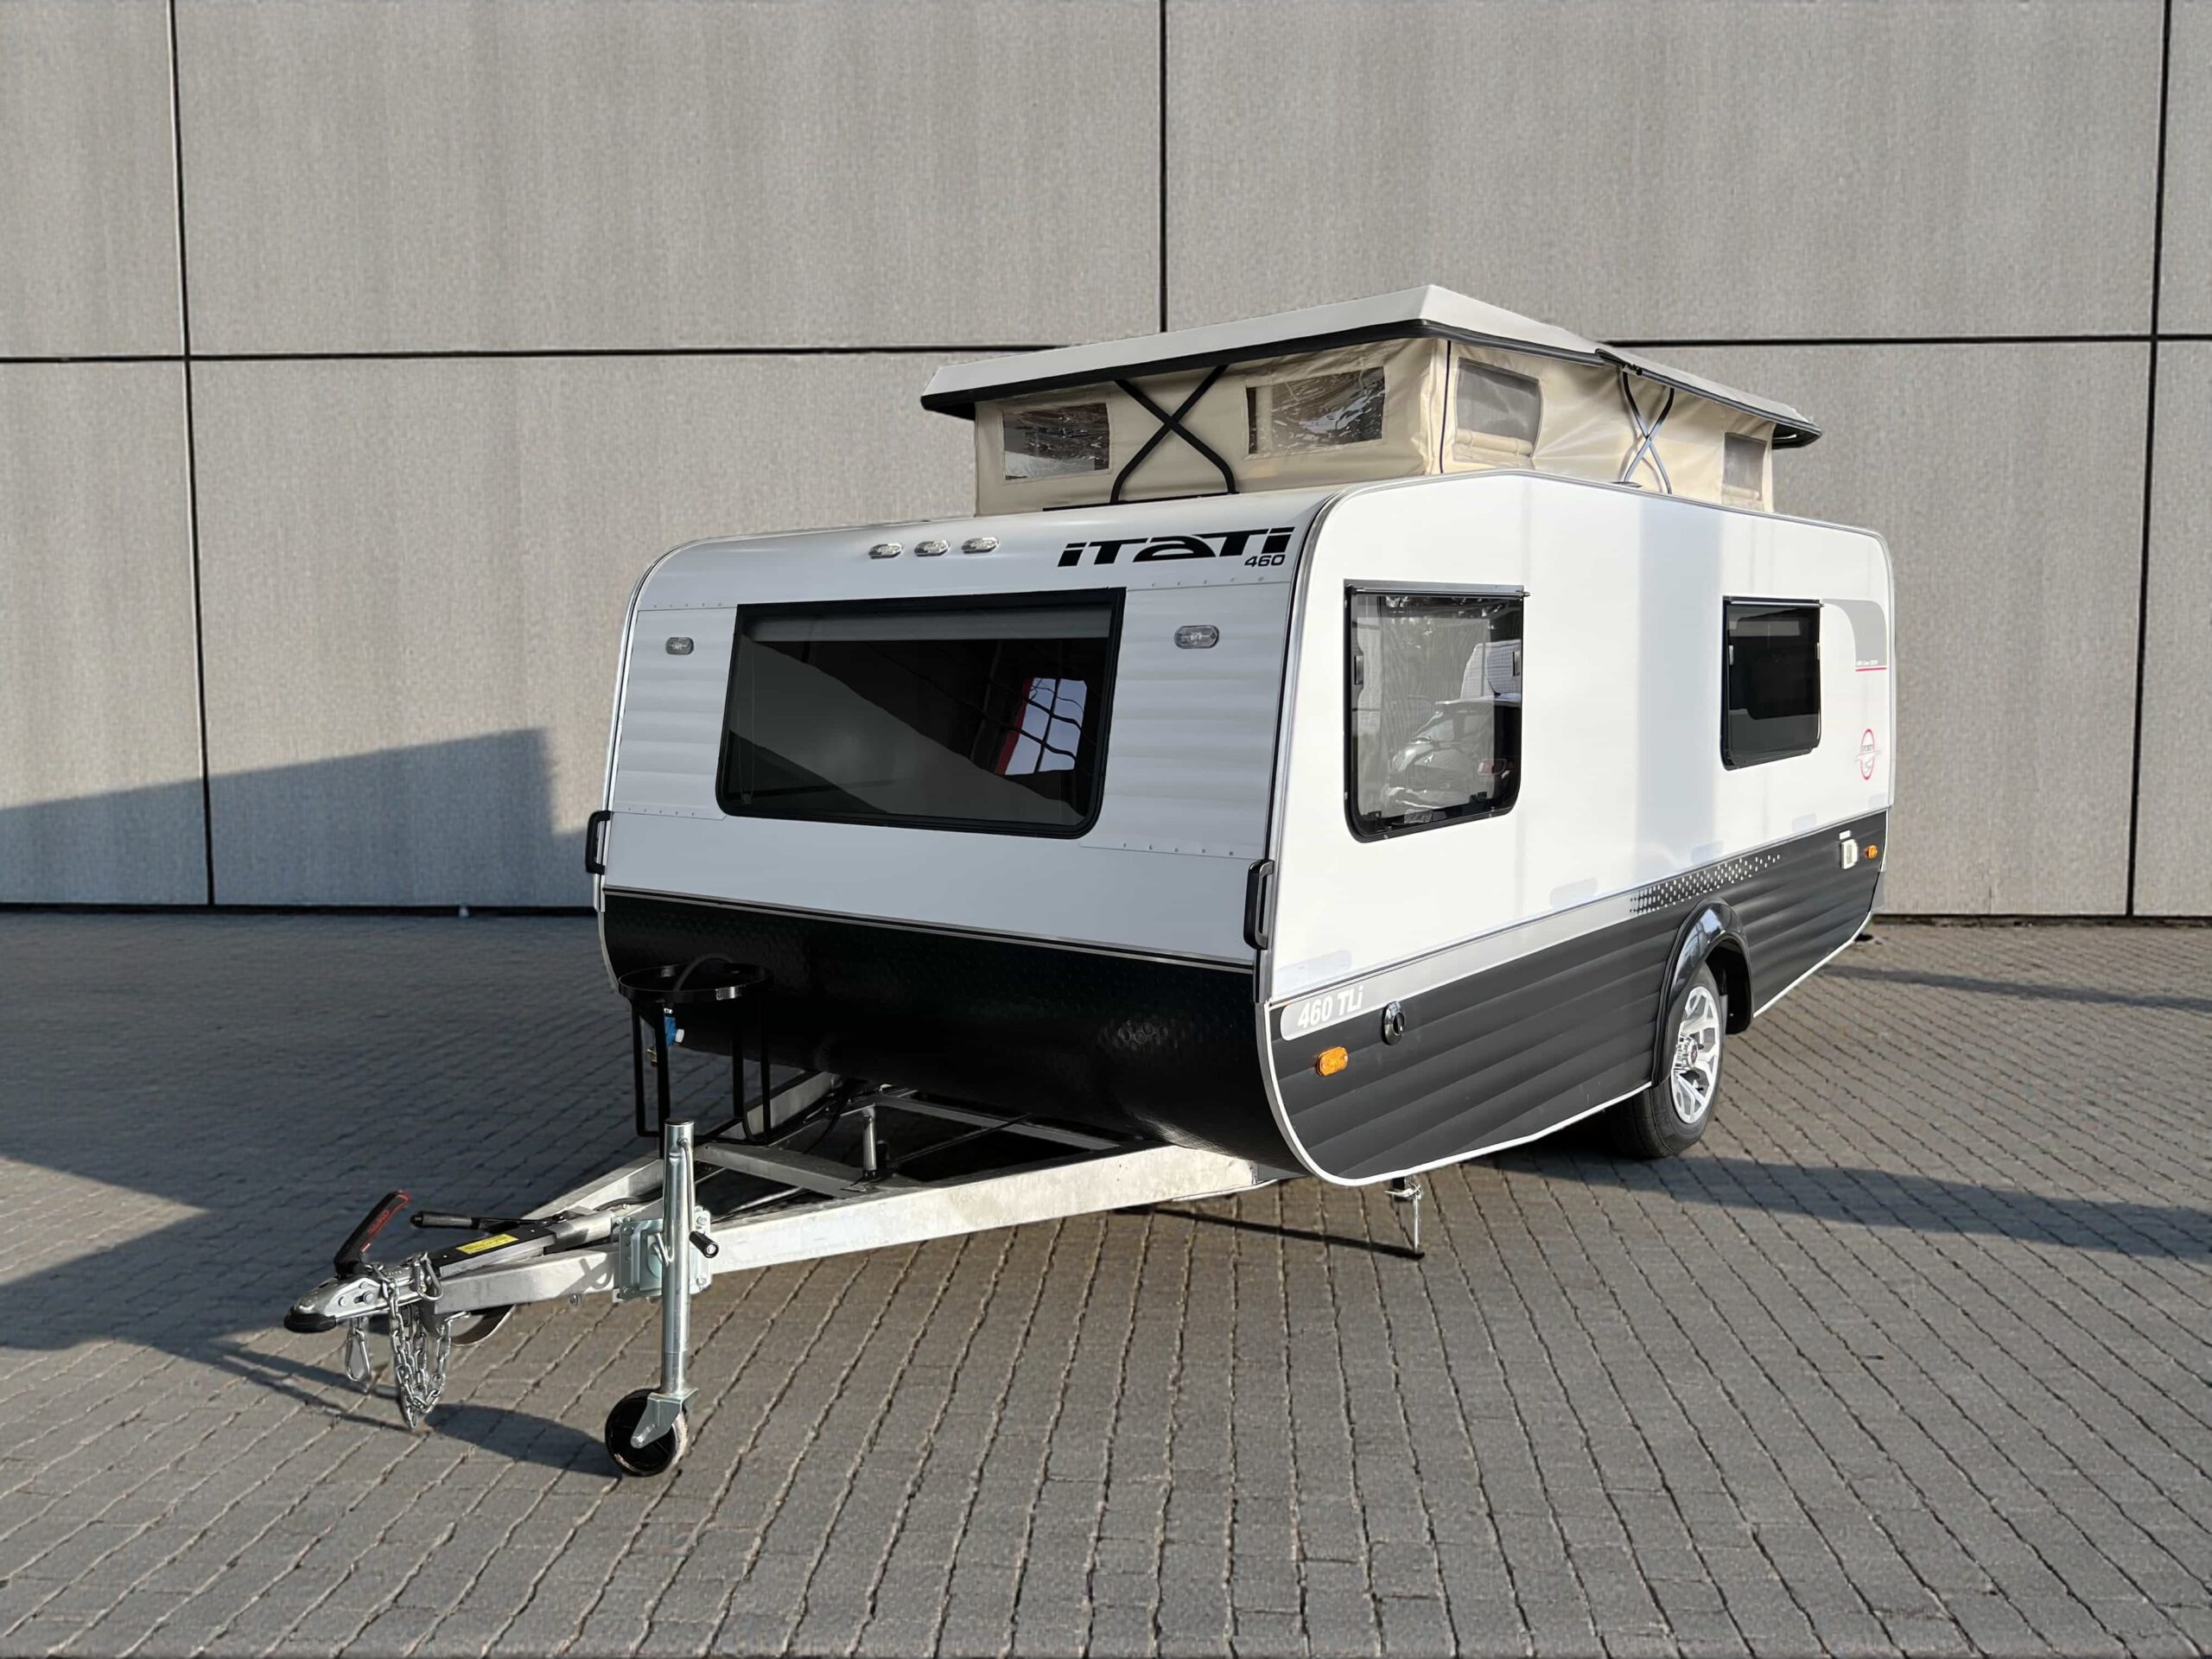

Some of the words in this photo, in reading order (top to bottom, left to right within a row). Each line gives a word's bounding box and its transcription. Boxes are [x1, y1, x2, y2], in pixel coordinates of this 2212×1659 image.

[1243, 554, 1286, 567] 460
[1298, 996, 1332, 1028] 460
[1338, 985, 1363, 1016] TLi
